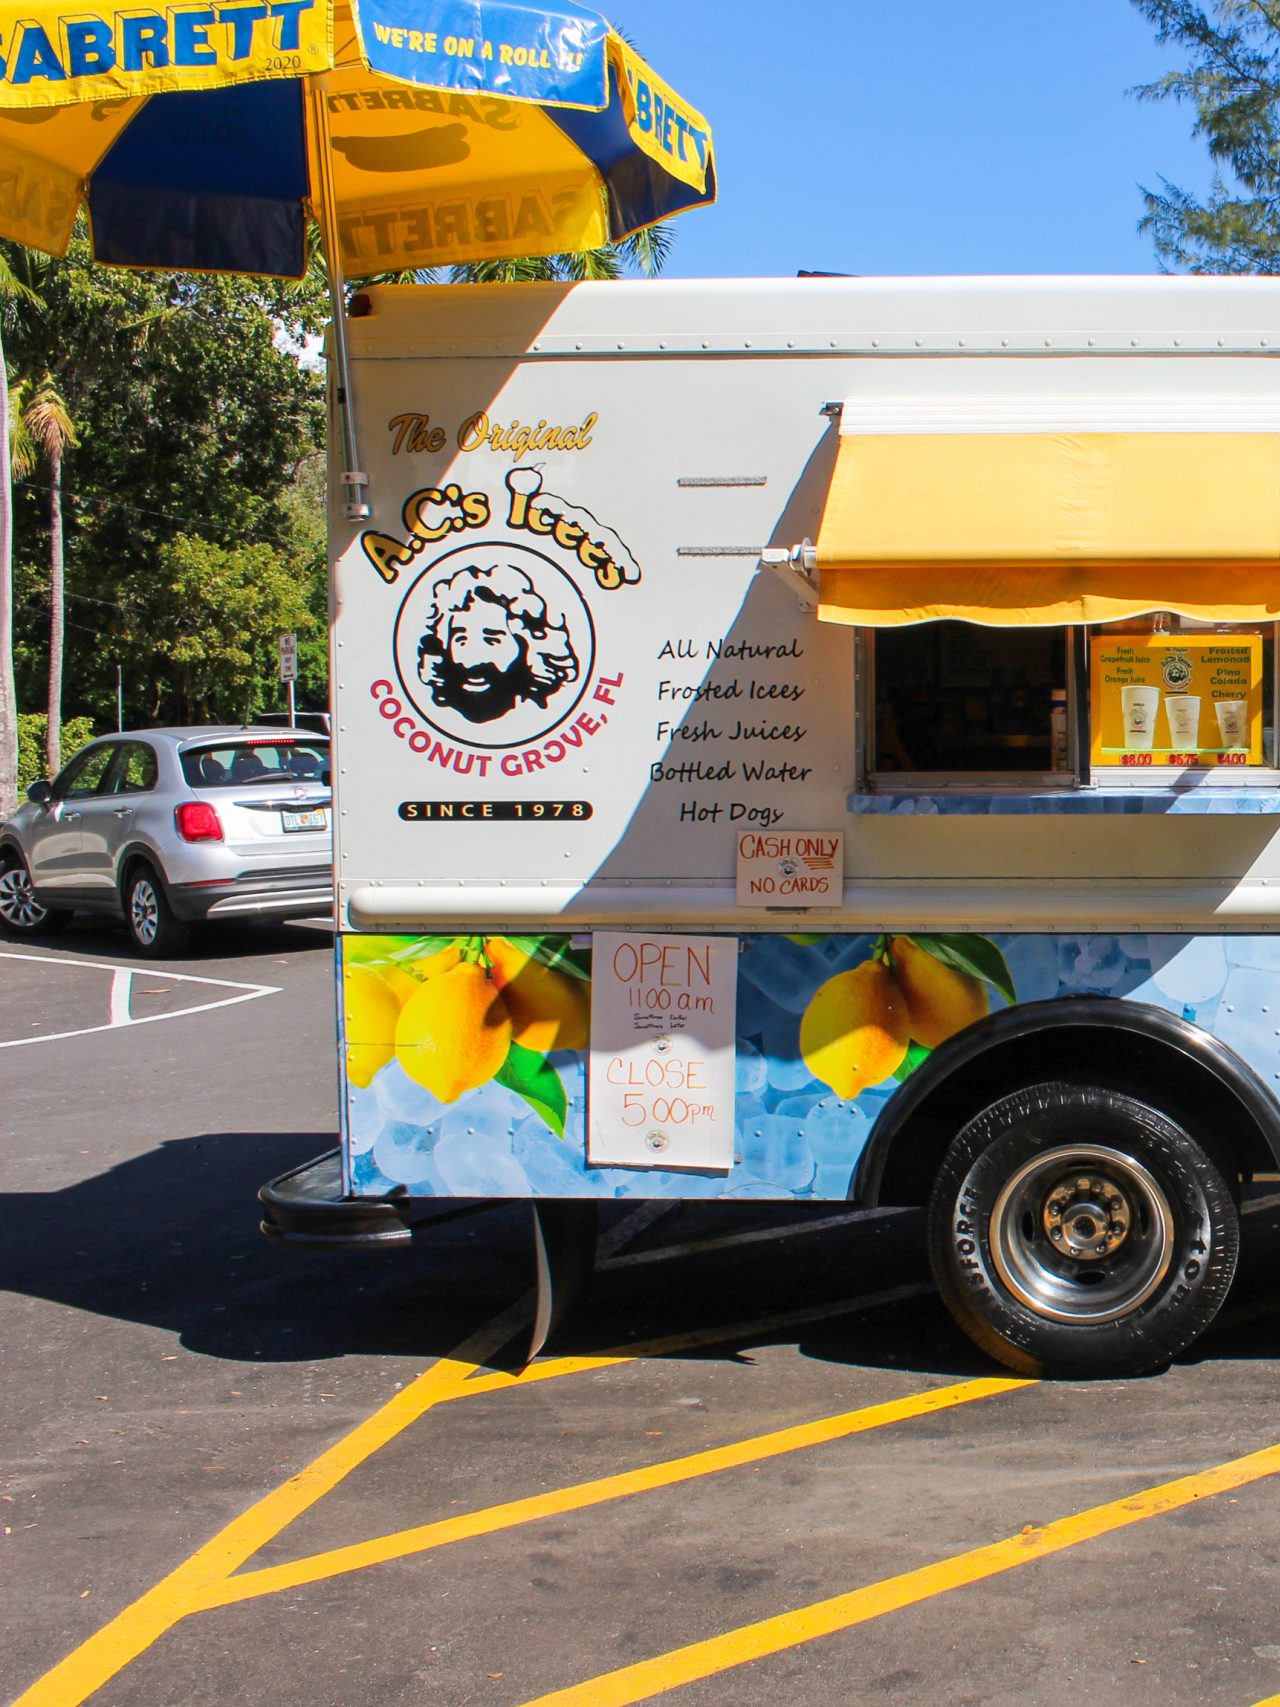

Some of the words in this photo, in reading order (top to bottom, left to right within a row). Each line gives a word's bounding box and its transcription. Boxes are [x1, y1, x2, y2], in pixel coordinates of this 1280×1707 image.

[0, 0, 316, 85] ABRETT
[373, 22, 437, 53] WE'RE
[443, 36, 474, 58] ON
[481, 41, 493, 61] A
[499, 44, 551, 68] ROLL
[264, 56, 301, 71] 2020
[627, 66, 709, 171] BRETT
[388, 412, 446, 455] The
[457, 411, 599, 462] Original
[505, 462, 642, 590] Icees
[657, 638, 698, 659] All
[706, 638, 804, 660] Natural
[657, 680, 744, 702] Frosted
[748, 680, 805, 702] Icees
[1210, 676, 1247, 684] Colada
[1211, 690, 1246, 699] Cherry
[370, 678, 493, 778] COCONUT
[500, 713, 609, 777] GROVE,
[593, 671, 624, 706] FL
[656, 722, 722, 743] Fresh
[728, 722, 807, 743] Juices
[650, 762, 735, 783] Bottled
[741, 763, 813, 783] Water
[406, 804, 495, 818] SINCE
[514, 804, 585, 818] 1978
[679, 801, 724, 823] Hot
[729, 802, 784, 826] Dogs
[740, 834, 791, 859] CASH
[795, 838, 839, 858] ONLY
[750, 877, 775, 893] NO
[779, 877, 829, 894] CARDS
[613, 943, 711, 987] OPEN
[606, 1057, 708, 1090] CLOSE
